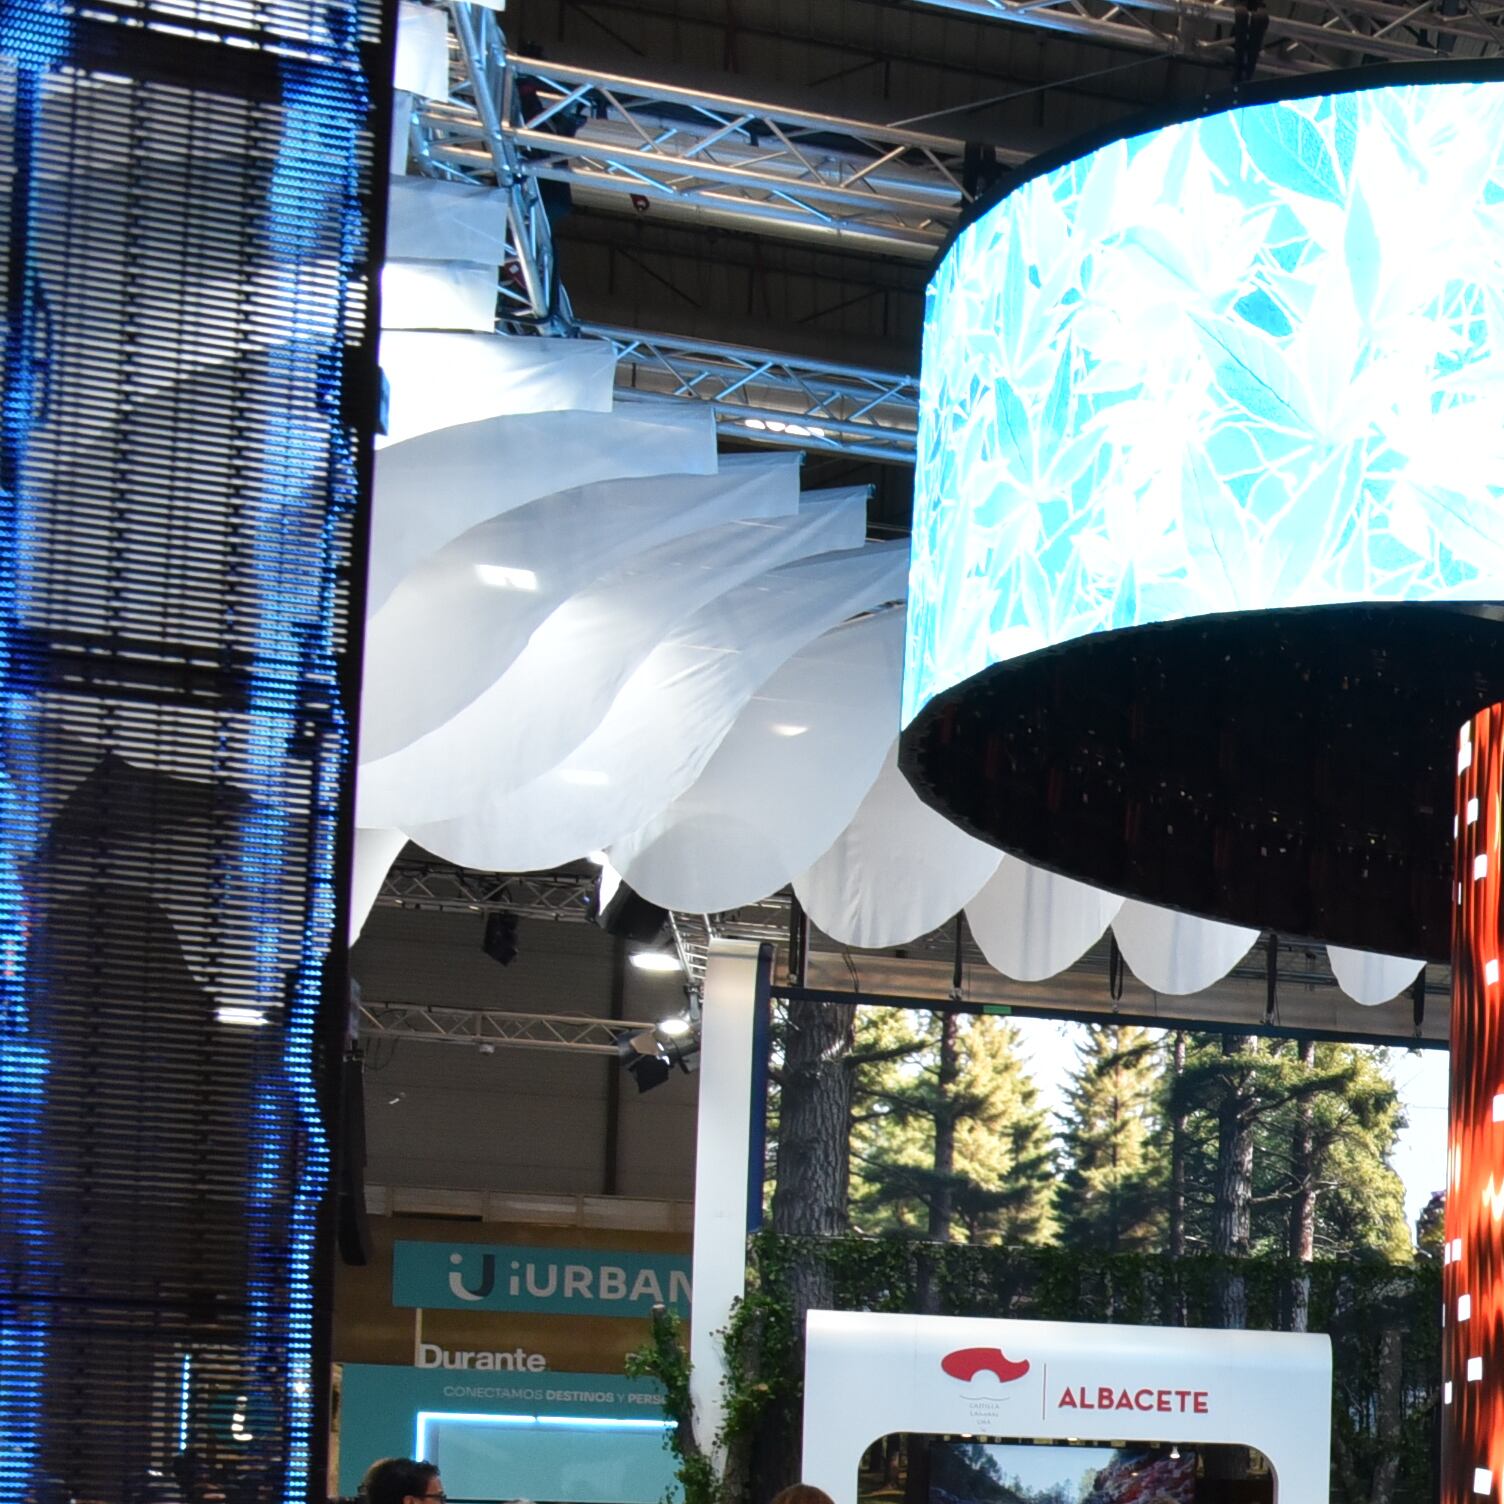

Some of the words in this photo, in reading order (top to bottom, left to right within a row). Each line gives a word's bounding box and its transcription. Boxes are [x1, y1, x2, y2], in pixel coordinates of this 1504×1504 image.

[420, 1343, 547, 1372] Durante
[443, 1385, 544, 1400] CONECTAMOS
[546, 1390, 615, 1403] DESTINOS
[617, 1394, 625, 1403] Y
[1057, 1386, 1209, 1414] ALBACETE
